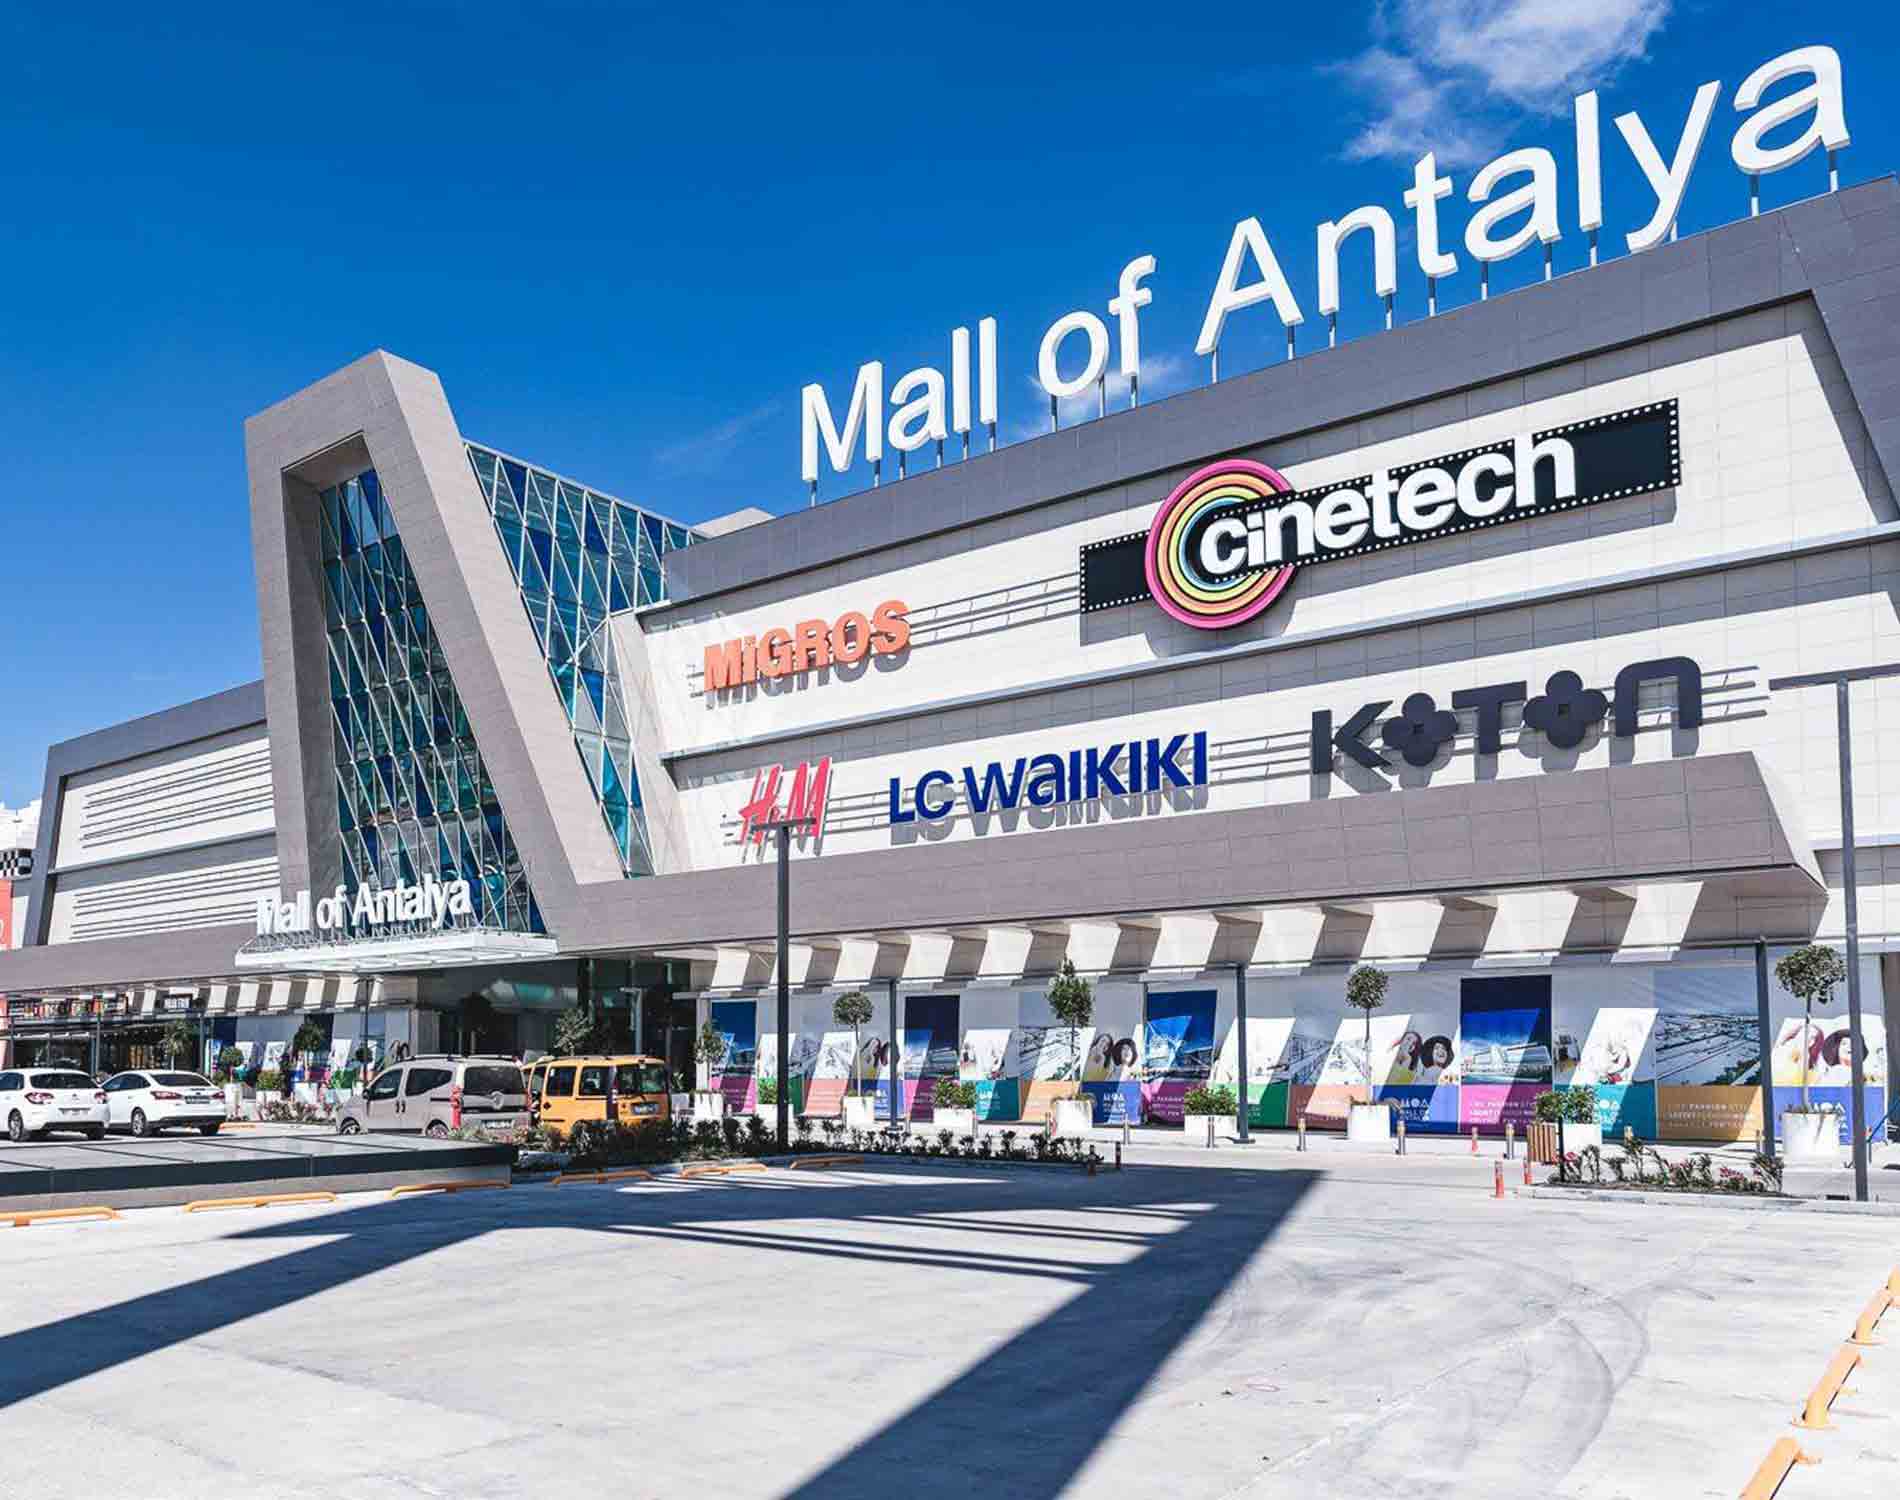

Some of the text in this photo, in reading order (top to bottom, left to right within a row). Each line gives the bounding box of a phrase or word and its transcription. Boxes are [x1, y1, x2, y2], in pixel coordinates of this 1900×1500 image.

[801, 45, 1850, 480] Mall of Antalya
[1199, 433, 1576, 575] cinetech
[889, 770, 954, 824] LC
[257, 873, 472, 935] Mall of Antalya
